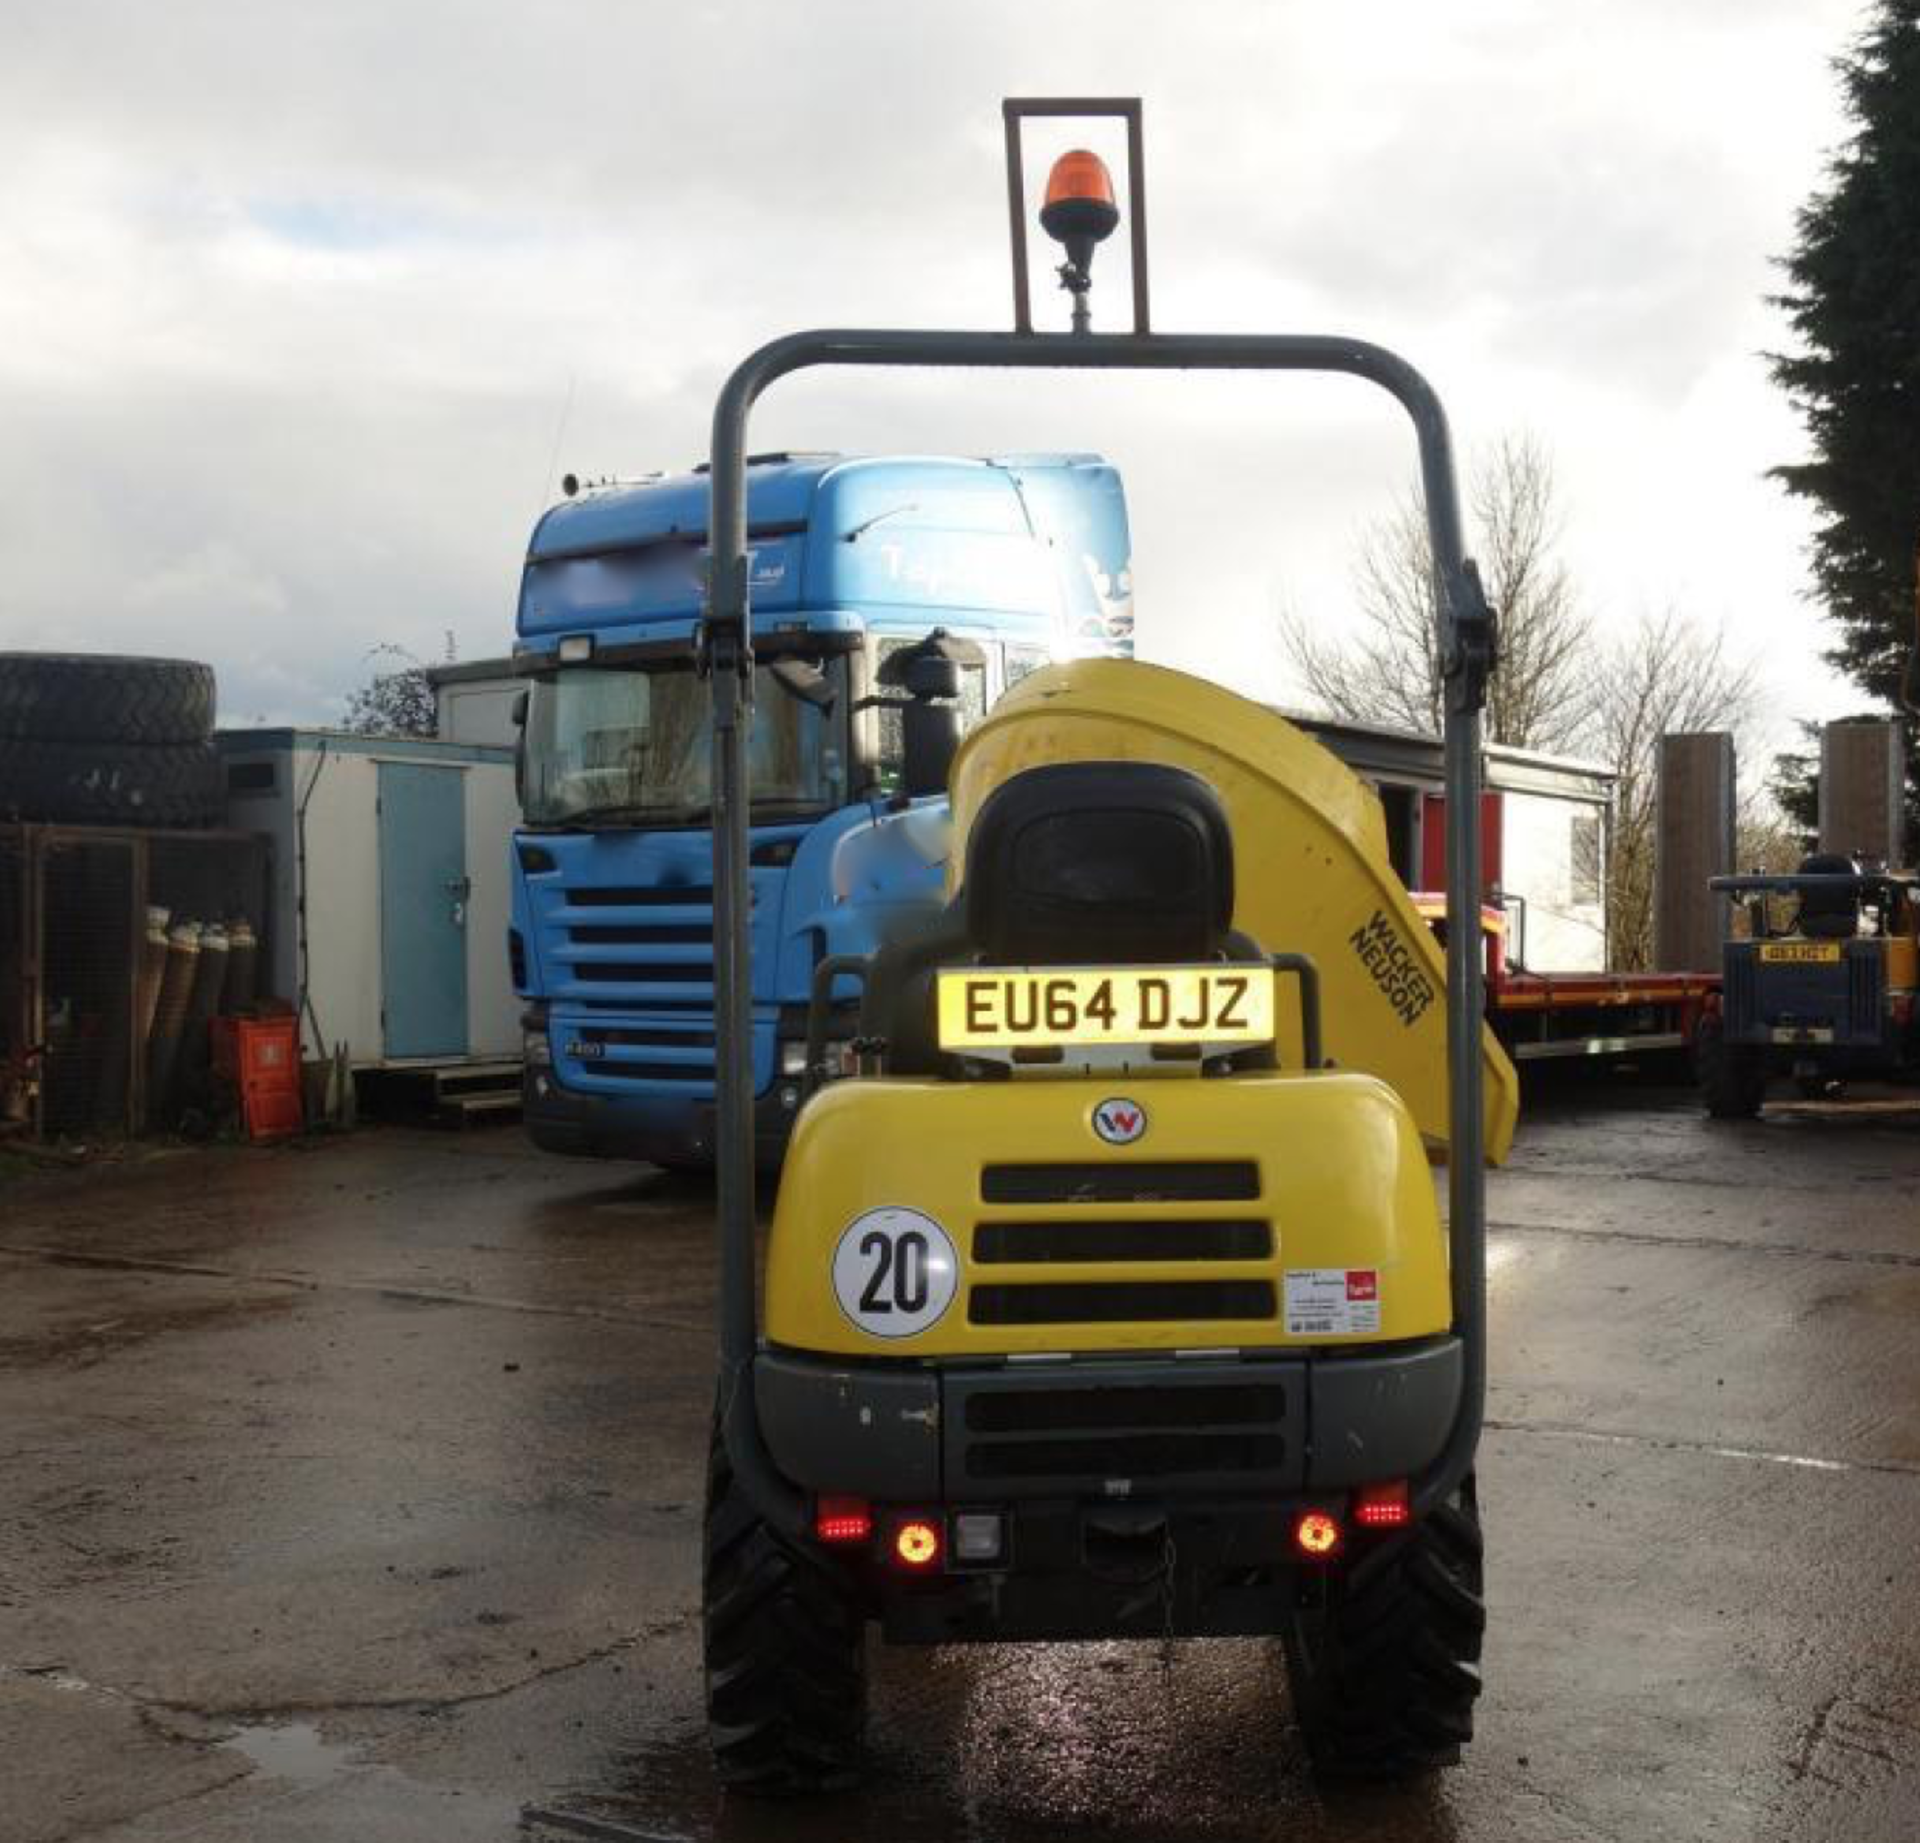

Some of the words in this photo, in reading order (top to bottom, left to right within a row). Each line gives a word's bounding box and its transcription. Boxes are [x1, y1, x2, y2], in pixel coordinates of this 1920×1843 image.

[965, 980, 1116, 1033] EU64
[1138, 977, 1248, 1030] DJZ
[1349, 927, 1421, 1027] NEUSON
[1368, 910, 1434, 1011] WACKER
[859, 1231, 929, 1314] 20
